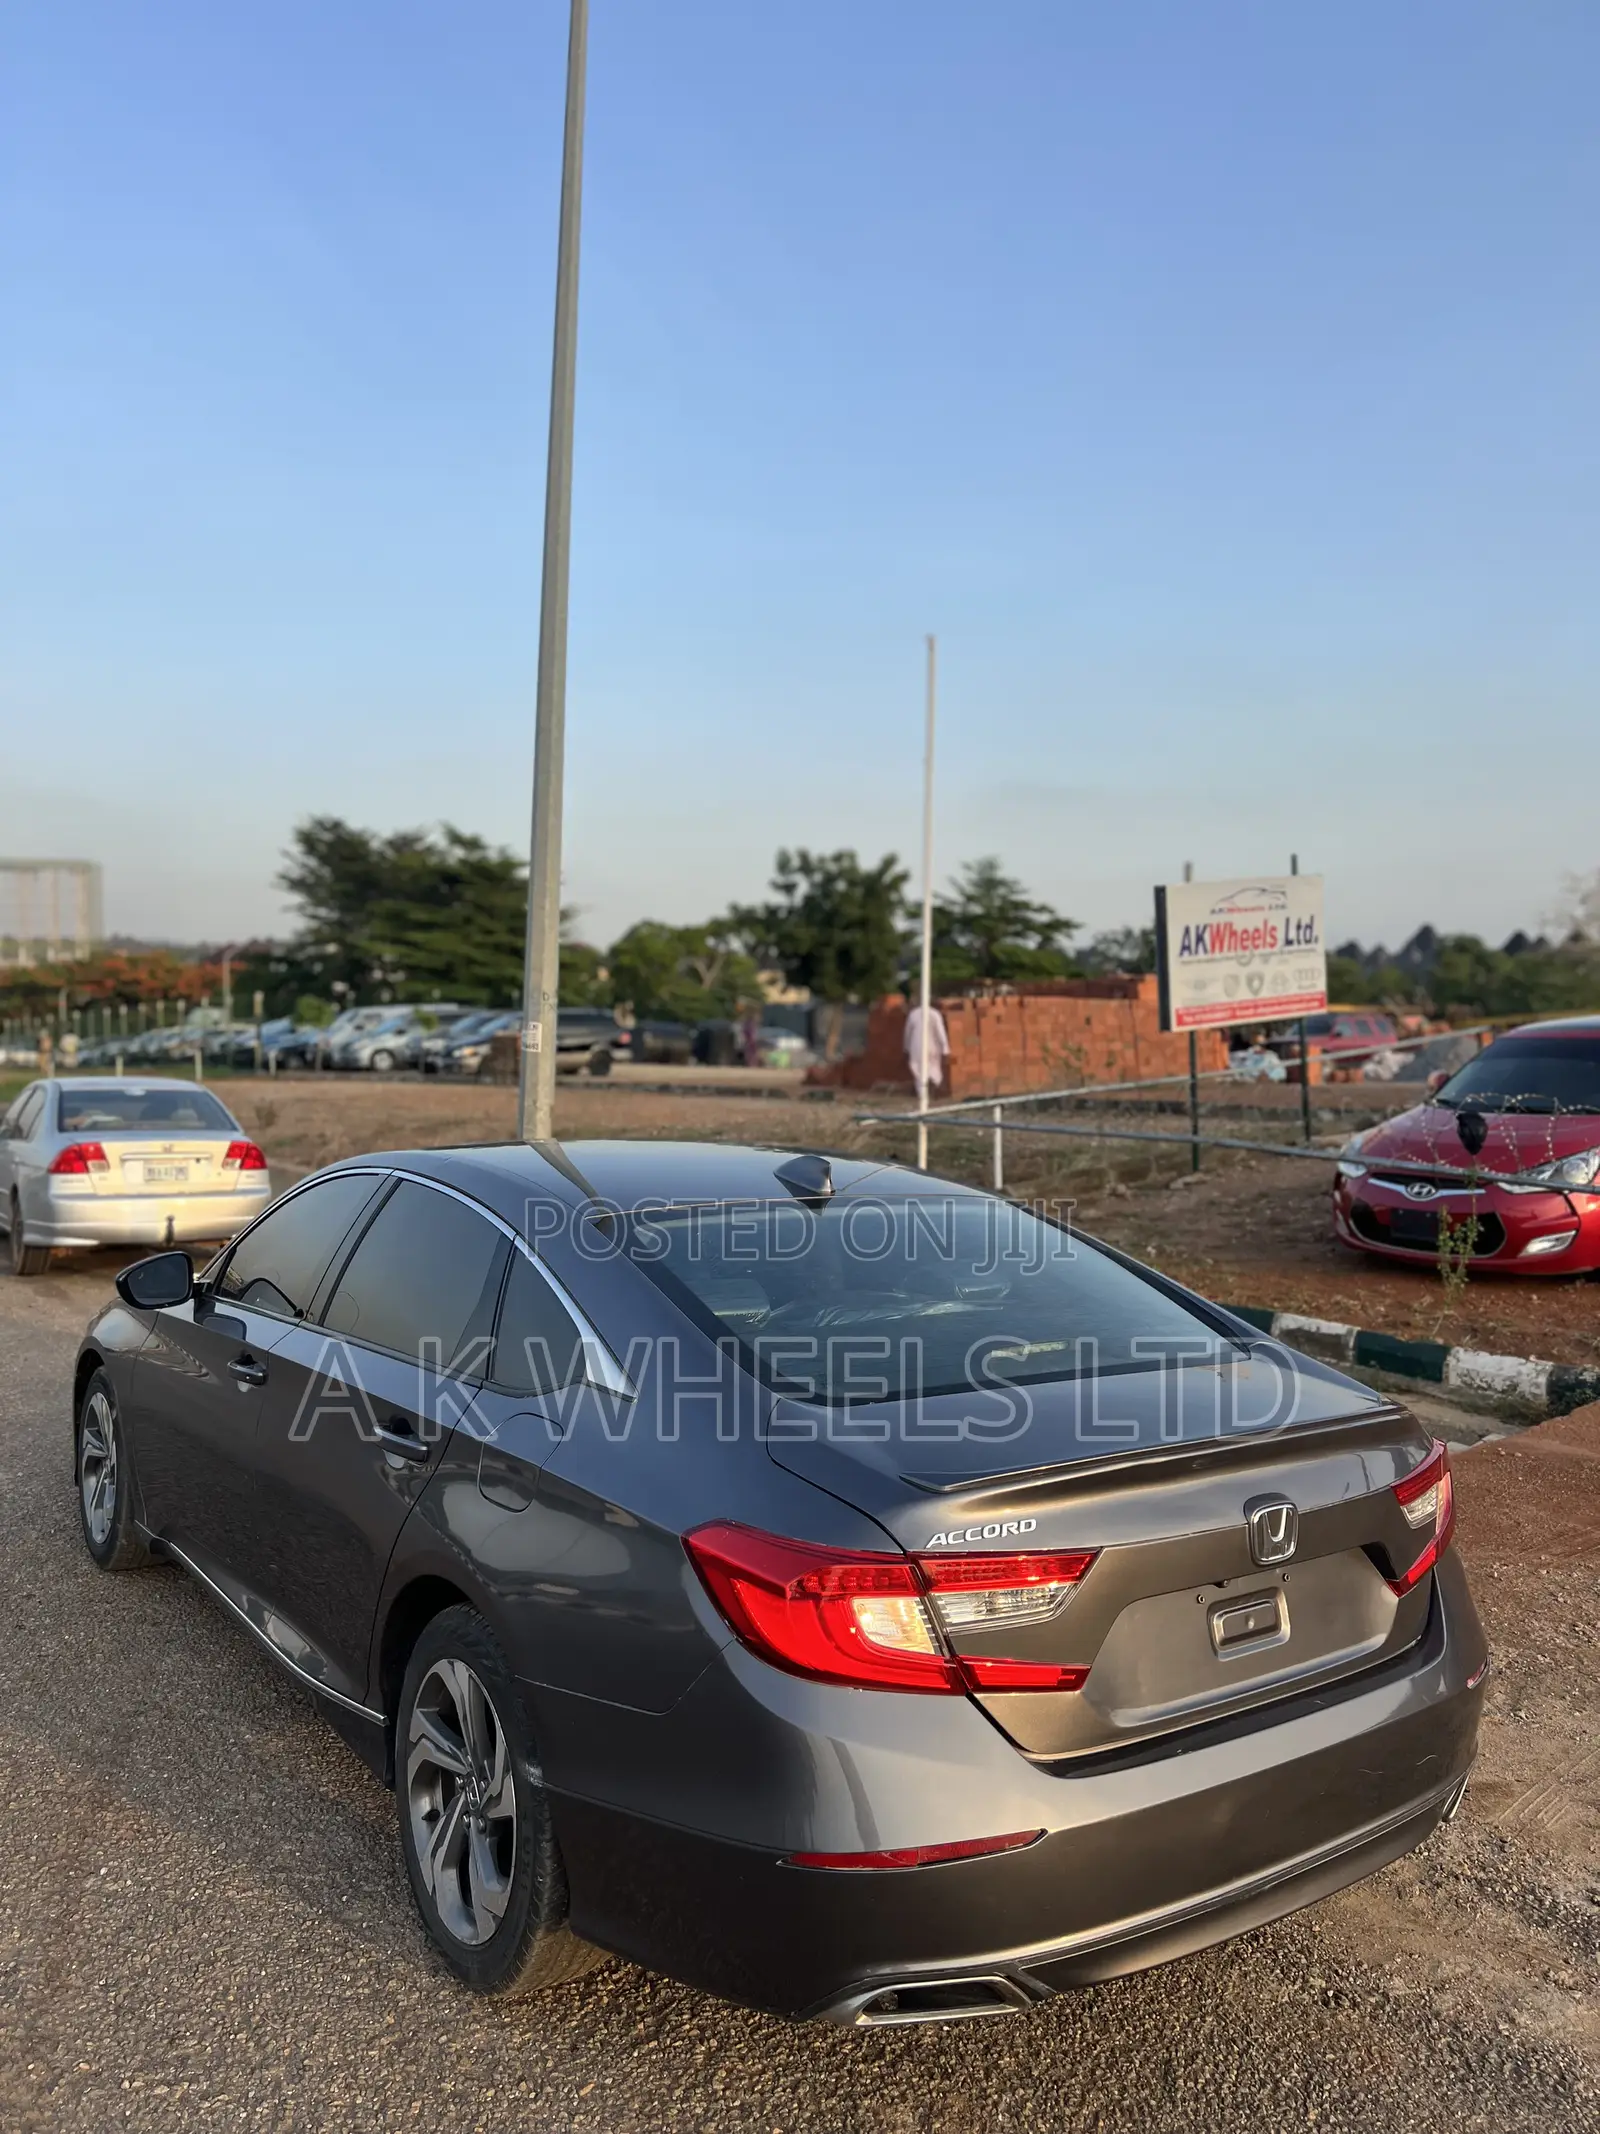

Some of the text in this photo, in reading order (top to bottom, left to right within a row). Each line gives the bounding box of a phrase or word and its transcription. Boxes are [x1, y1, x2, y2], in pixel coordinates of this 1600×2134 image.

[1179, 914, 1318, 957] AKWheels Ltd.
[924, 1518, 1037, 1549] ACCORD
